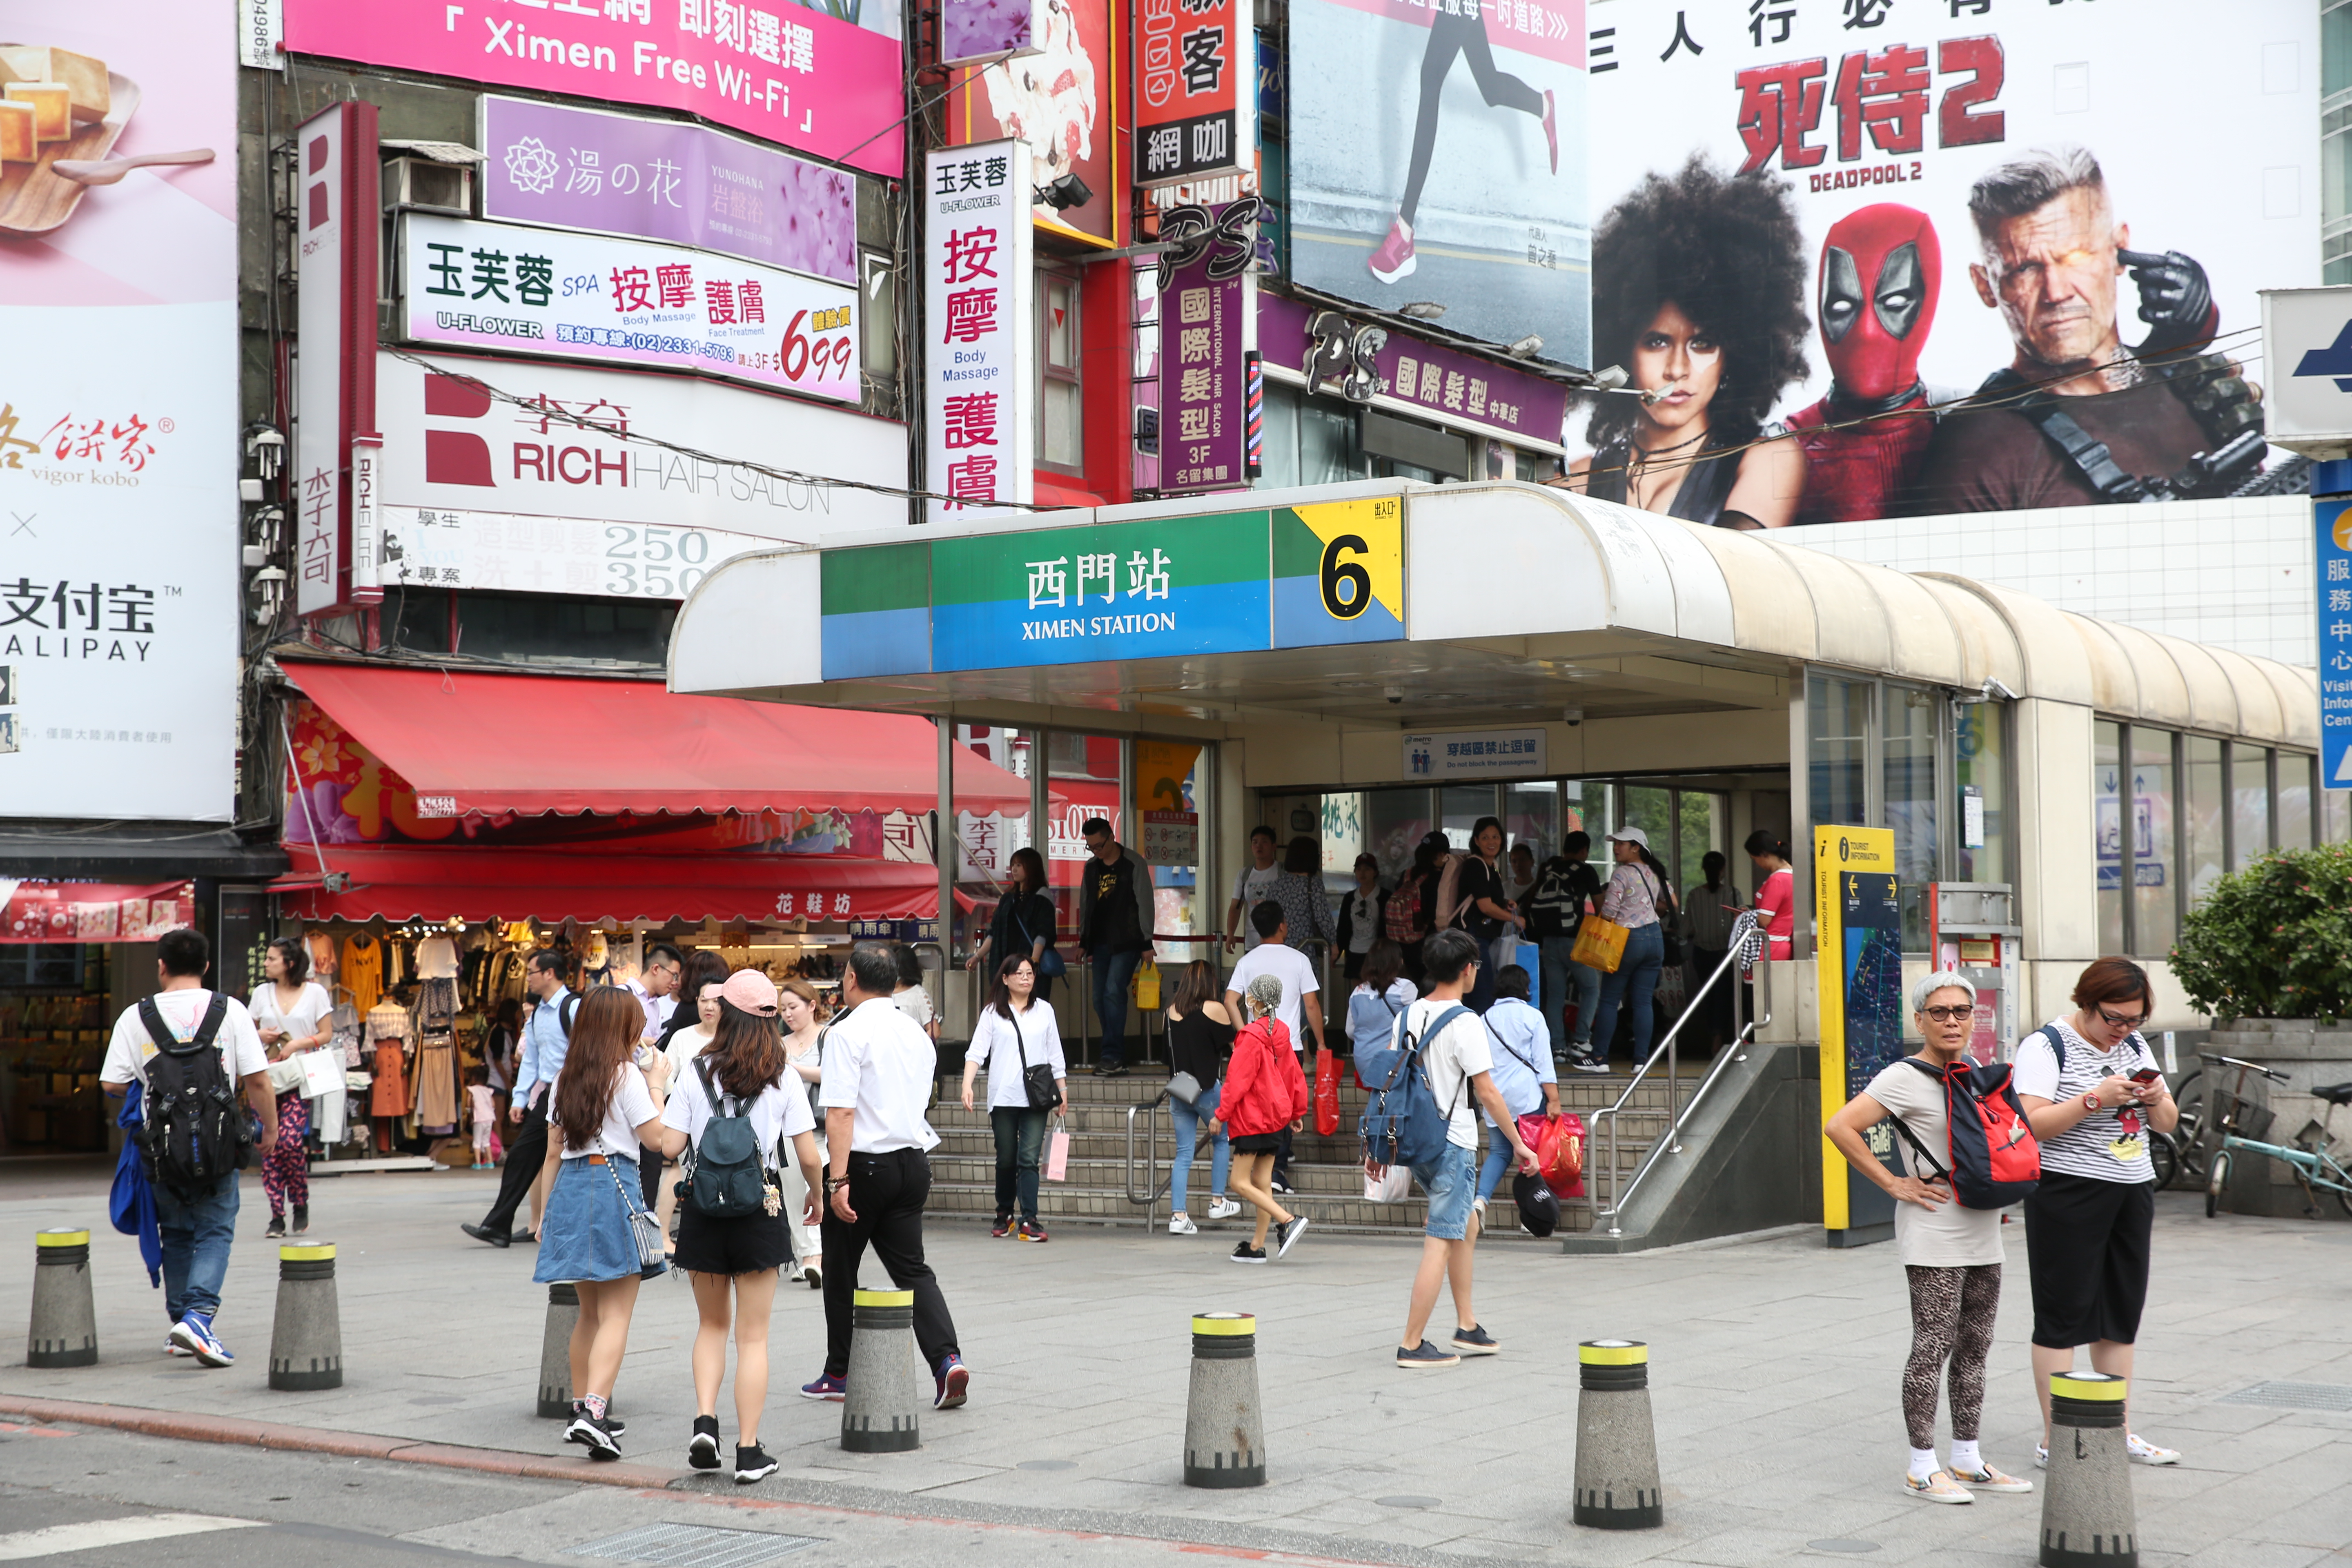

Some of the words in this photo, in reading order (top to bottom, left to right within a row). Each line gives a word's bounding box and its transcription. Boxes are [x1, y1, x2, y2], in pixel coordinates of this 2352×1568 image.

[678, 0, 814, 74] 即刻選擇
[634, 41, 706, 89] Free
[1148, 118, 1227, 172] 網咖
[566, 147, 682, 208] 湯の花
[712, 165, 764, 191] YUNOHANA
[935, 156, 1007, 195] 玉芙蓉
[1809, 163, 1907, 193] DEADPOOL
[1911, 162, 1922, 180] 2
[711, 183, 764, 225] 岩盤浴
[941, 195, 1000, 214] U-FLOWER
[1528, 244, 1556, 270] 曾之喬
[426, 243, 553, 306] 玉芙蓉
[562, 274, 599, 297] SPA
[610, 263, 696, 312] 按摩
[705, 279, 765, 325] 護膚
[944, 226, 998, 344] 按摩
[437, 311, 545, 340] U-FLOWER
[623, 315, 649, 327] Body
[653, 312, 696, 324] Massage
[709, 328, 727, 338] Face
[729, 327, 765, 337] Treatment
[812, 305, 851, 333] 體驗價
[1213, 287, 1222, 369] INTERNATIONAL
[955, 350, 986, 364] Body
[1180, 287, 1211, 442] 國際髮型
[943, 367, 999, 382] Massage
[1214, 373, 1222, 399] HAIR
[1395, 355, 1488, 417] 國際髮型
[1490, 399, 1519, 425] 中華店
[1213, 403, 1221, 438] SALON
[943, 391, 998, 511] 護膚
[1189, 445, 1211, 464] 3F
[32, 466, 84, 486] vigor
[90, 468, 139, 488] kobo
[514, 442, 628, 487] RICH
[635, 451, 719, 496] HAIR
[731, 463, 830, 515] SALON
[1176, 465, 1227, 484] 名留集團
[418, 510, 461, 529] 學生
[1375, 501, 1393, 516] 出入口
[604, 526, 708, 564] 250
[418, 566, 461, 584] 專案
[605, 562, 706, 597] 350
[1025, 548, 1172, 610] 西門站
[1322, 534, 1371, 617] 6
[0, 578, 154, 633] 支付宝
[2327, 558, 2352, 671] 服務中心
[1022, 617, 1085, 641] XIMEN
[1091, 611, 1176, 637] STATION
[6, 635, 151, 662] ALIPAY
[1447, 739, 1536, 757] 穿越區禁止逗留
[1499, 759, 1537, 767] passageway
[1850, 842, 1869, 851] TOURIST
[1851, 852, 1880, 862] INFORMATION
[776, 893, 851, 914] 花鞋坊
[850, 922, 891, 936] 晴雨傘
